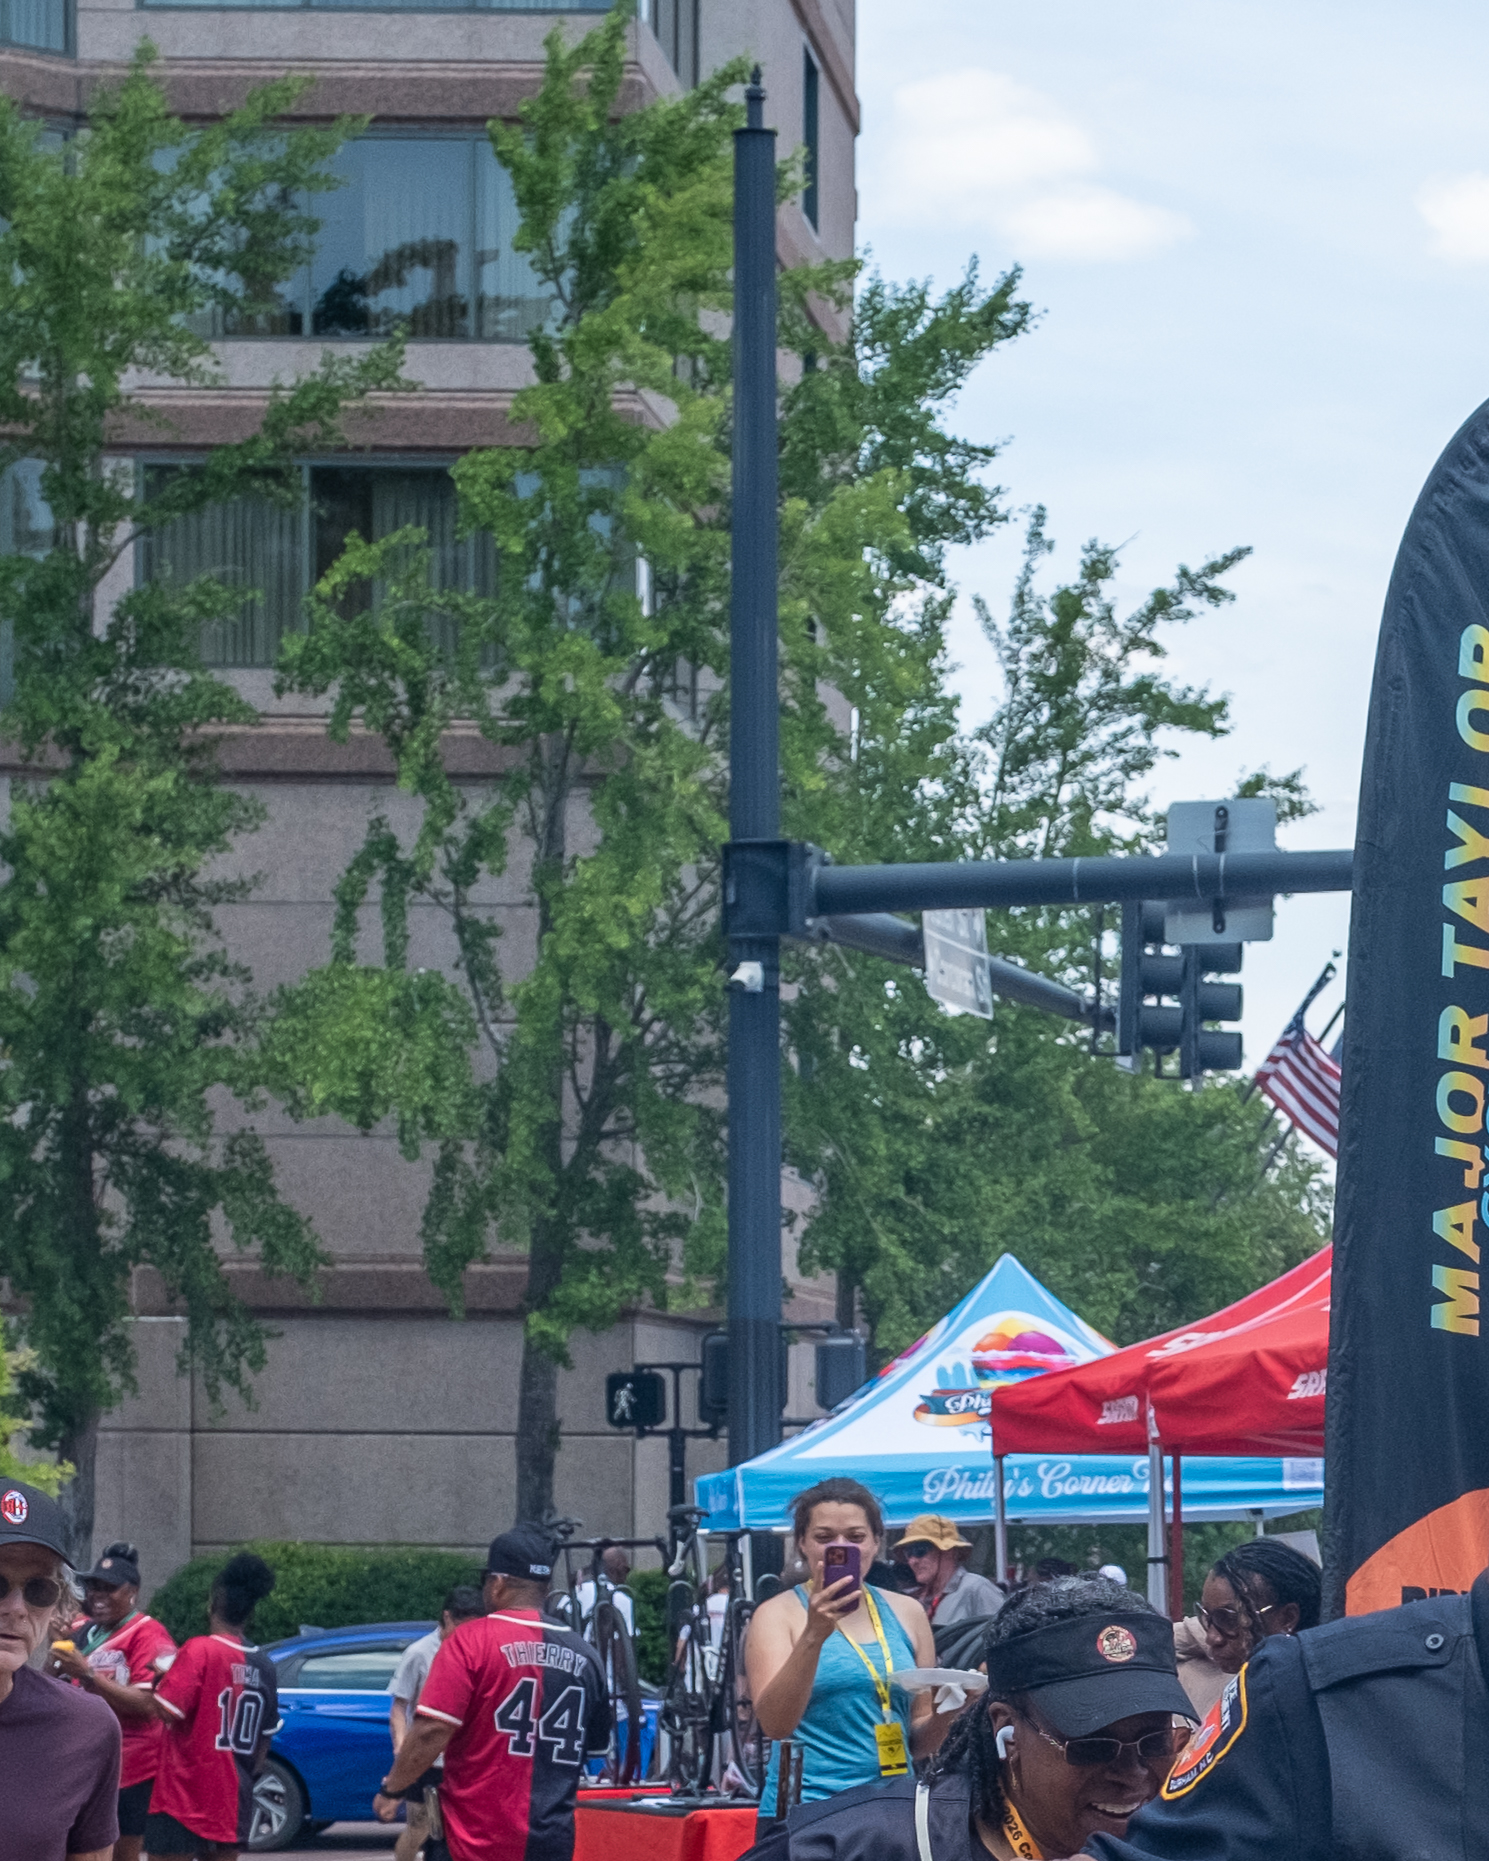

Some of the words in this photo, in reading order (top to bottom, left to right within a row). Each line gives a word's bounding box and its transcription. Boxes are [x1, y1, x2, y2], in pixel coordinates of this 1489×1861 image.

[1037, 1462, 1136, 1498] Corner
[500, 1640, 588, 1677] THIERRY
[215, 1687, 265, 1755] 10
[494, 1677, 586, 1765] 44
